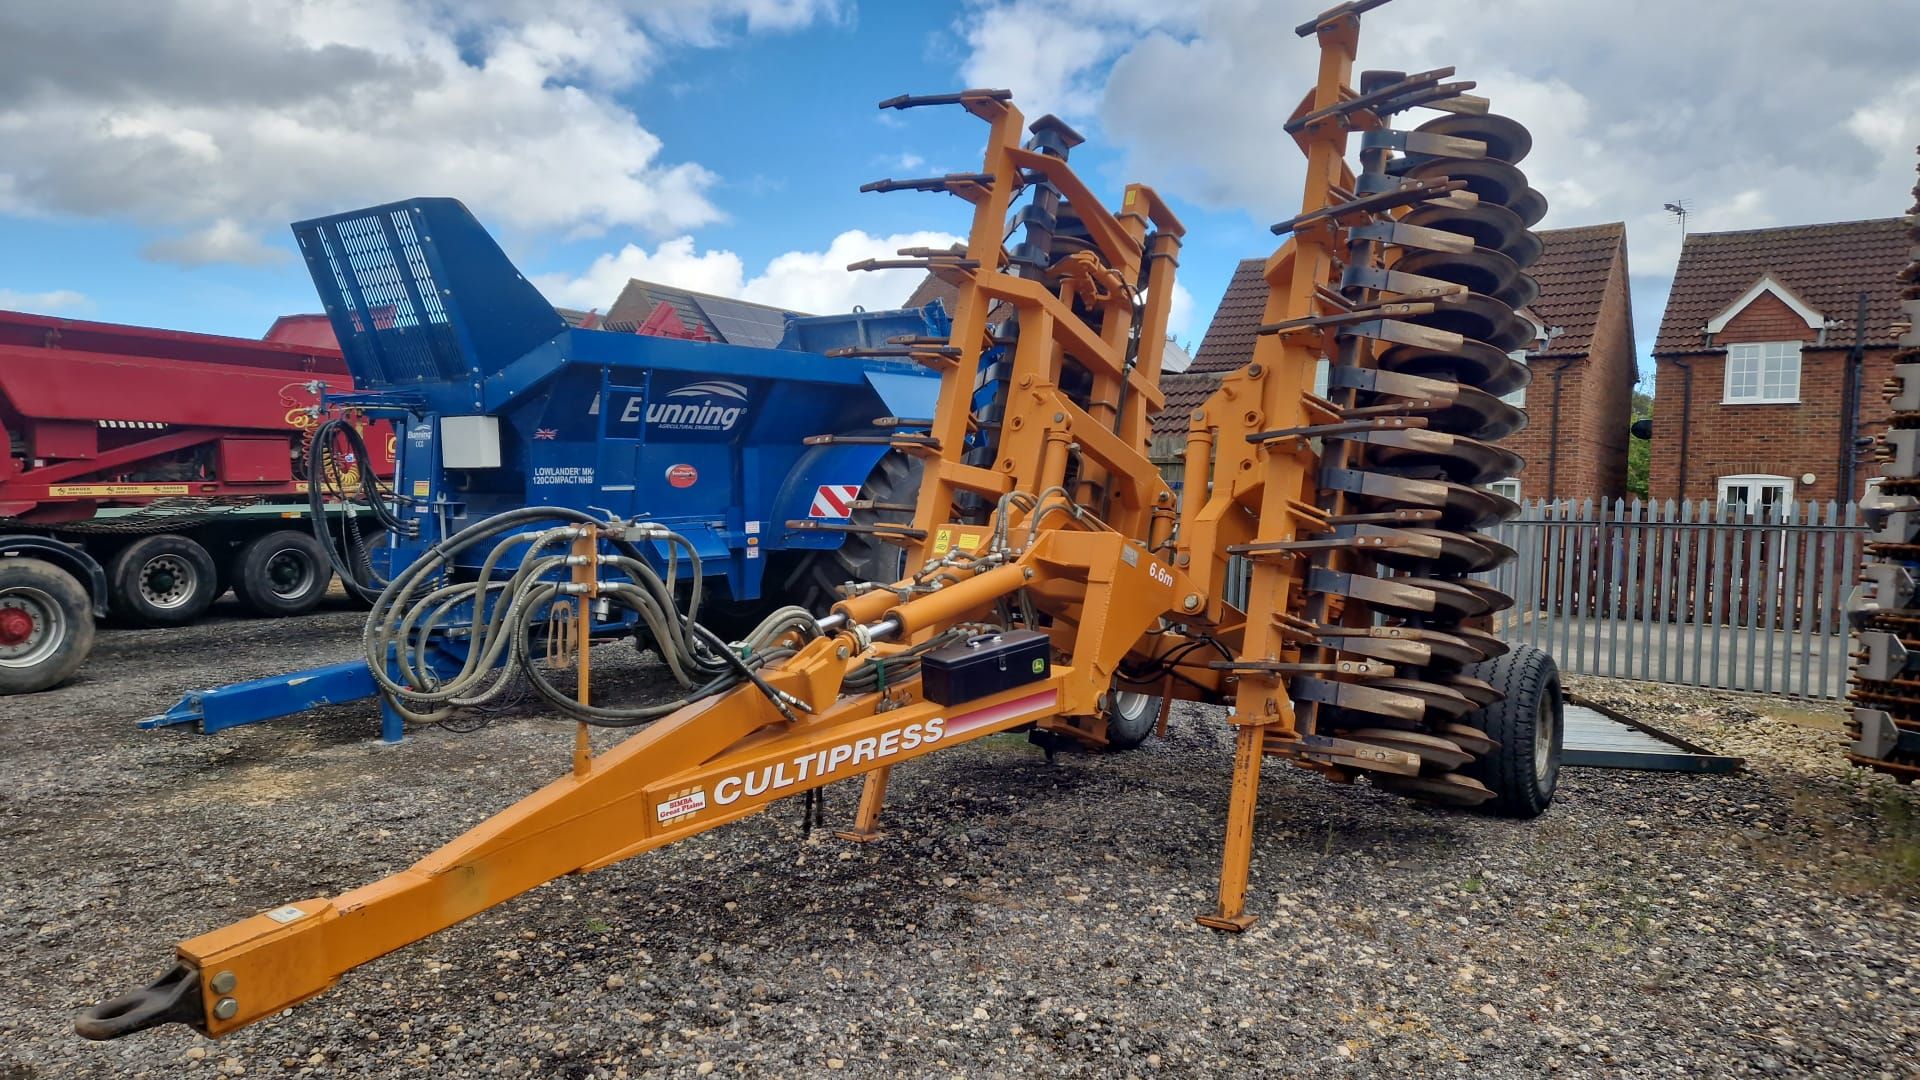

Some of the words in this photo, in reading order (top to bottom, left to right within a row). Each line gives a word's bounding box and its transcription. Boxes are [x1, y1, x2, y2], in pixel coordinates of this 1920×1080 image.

[1149, 562, 1174, 588] 6.6m
[713, 717, 945, 806] CULTIPRESS
[660, 808, 681, 818] Great
[681, 801, 704, 812] Plains
[669, 797, 693, 809] SIMBA
